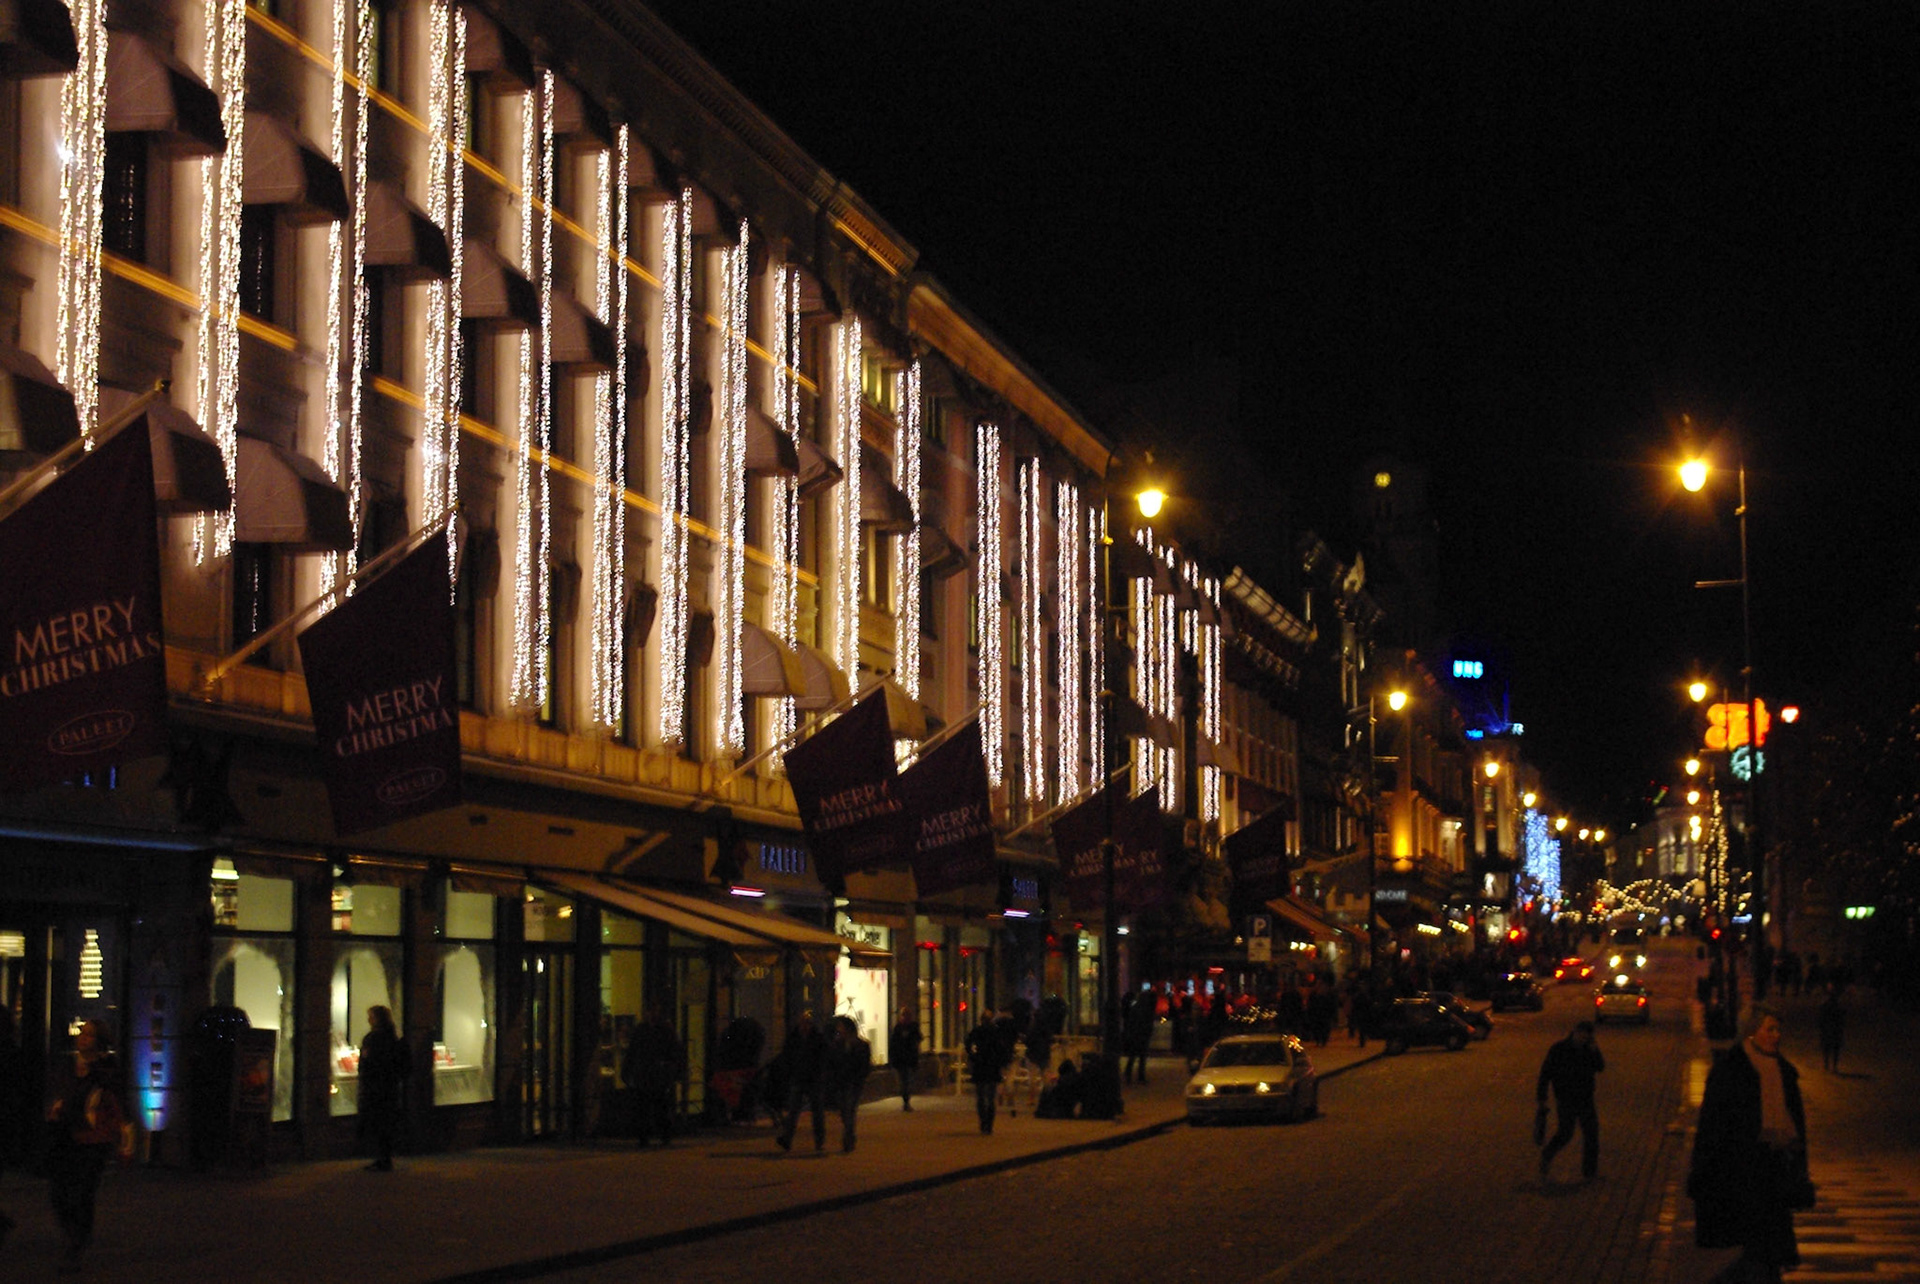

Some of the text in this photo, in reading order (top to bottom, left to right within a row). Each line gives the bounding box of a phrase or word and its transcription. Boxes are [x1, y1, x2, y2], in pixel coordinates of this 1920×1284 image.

[15, 595, 135, 664] MERRY
[0, 631, 161, 697] CHRISTMAS
[347, 674, 442, 732] MERRY
[335, 708, 454, 757] CHRISTMA
[921, 803, 981, 836] MERRY
[1253, 917, 1267, 935] P
